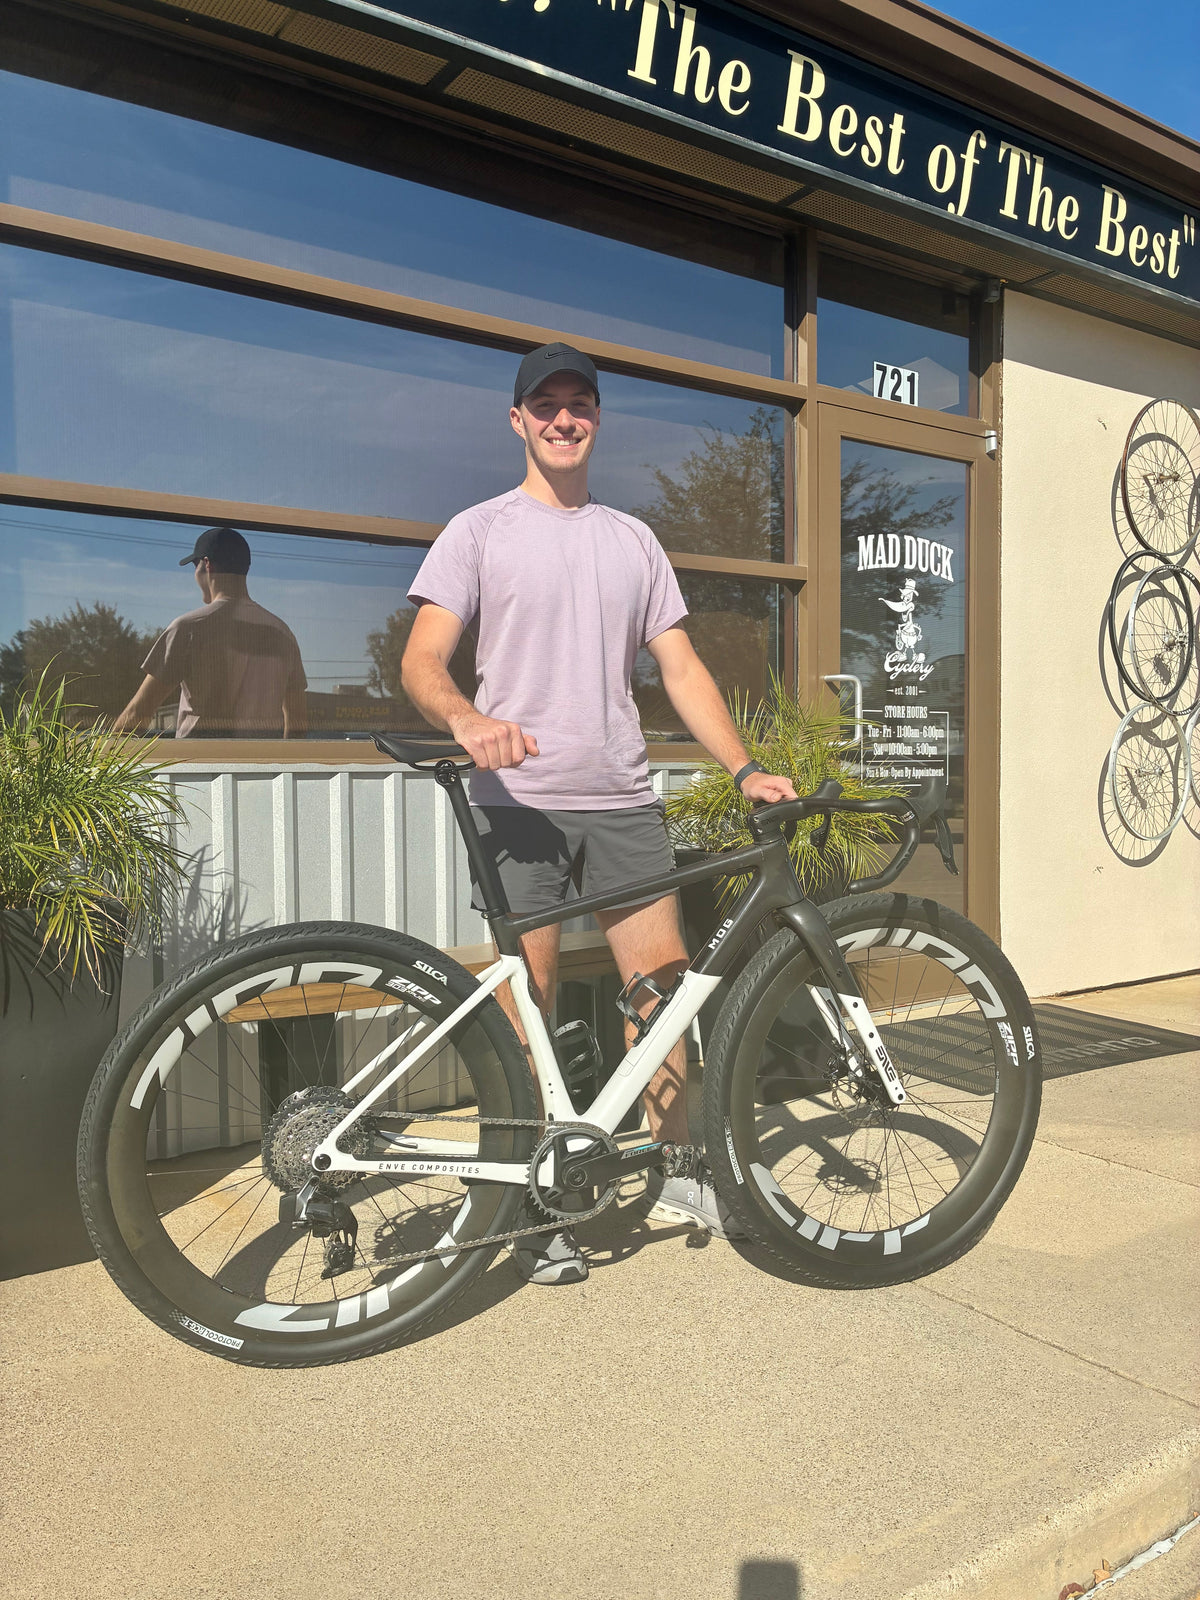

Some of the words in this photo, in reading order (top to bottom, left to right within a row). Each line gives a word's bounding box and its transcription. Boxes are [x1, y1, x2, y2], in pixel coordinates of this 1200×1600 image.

[596, 0, 751, 116] The
[777, 48, 906, 175] Best
[927, 129, 987, 217] of
[998, 140, 1079, 240] The
[1095, 183, 1195, 279] Best"
[875, 363, 916, 405] 721
[857, 533, 900, 571] MAD
[903, 534, 954, 582] DUCK
[884, 651, 934, 681] Cyclery
[884, 705, 905, 719] STORE
[906, 705, 928, 719] HOURS
[708, 918, 734, 950] MOG
[411, 960, 448, 986] SILCA
[387, 975, 442, 1005] ZIPP
[1022, 1026, 1036, 1061] SILCA
[378, 1163, 406, 1171] ENVE
[411, 1164, 480, 1174] COMPOSITES
